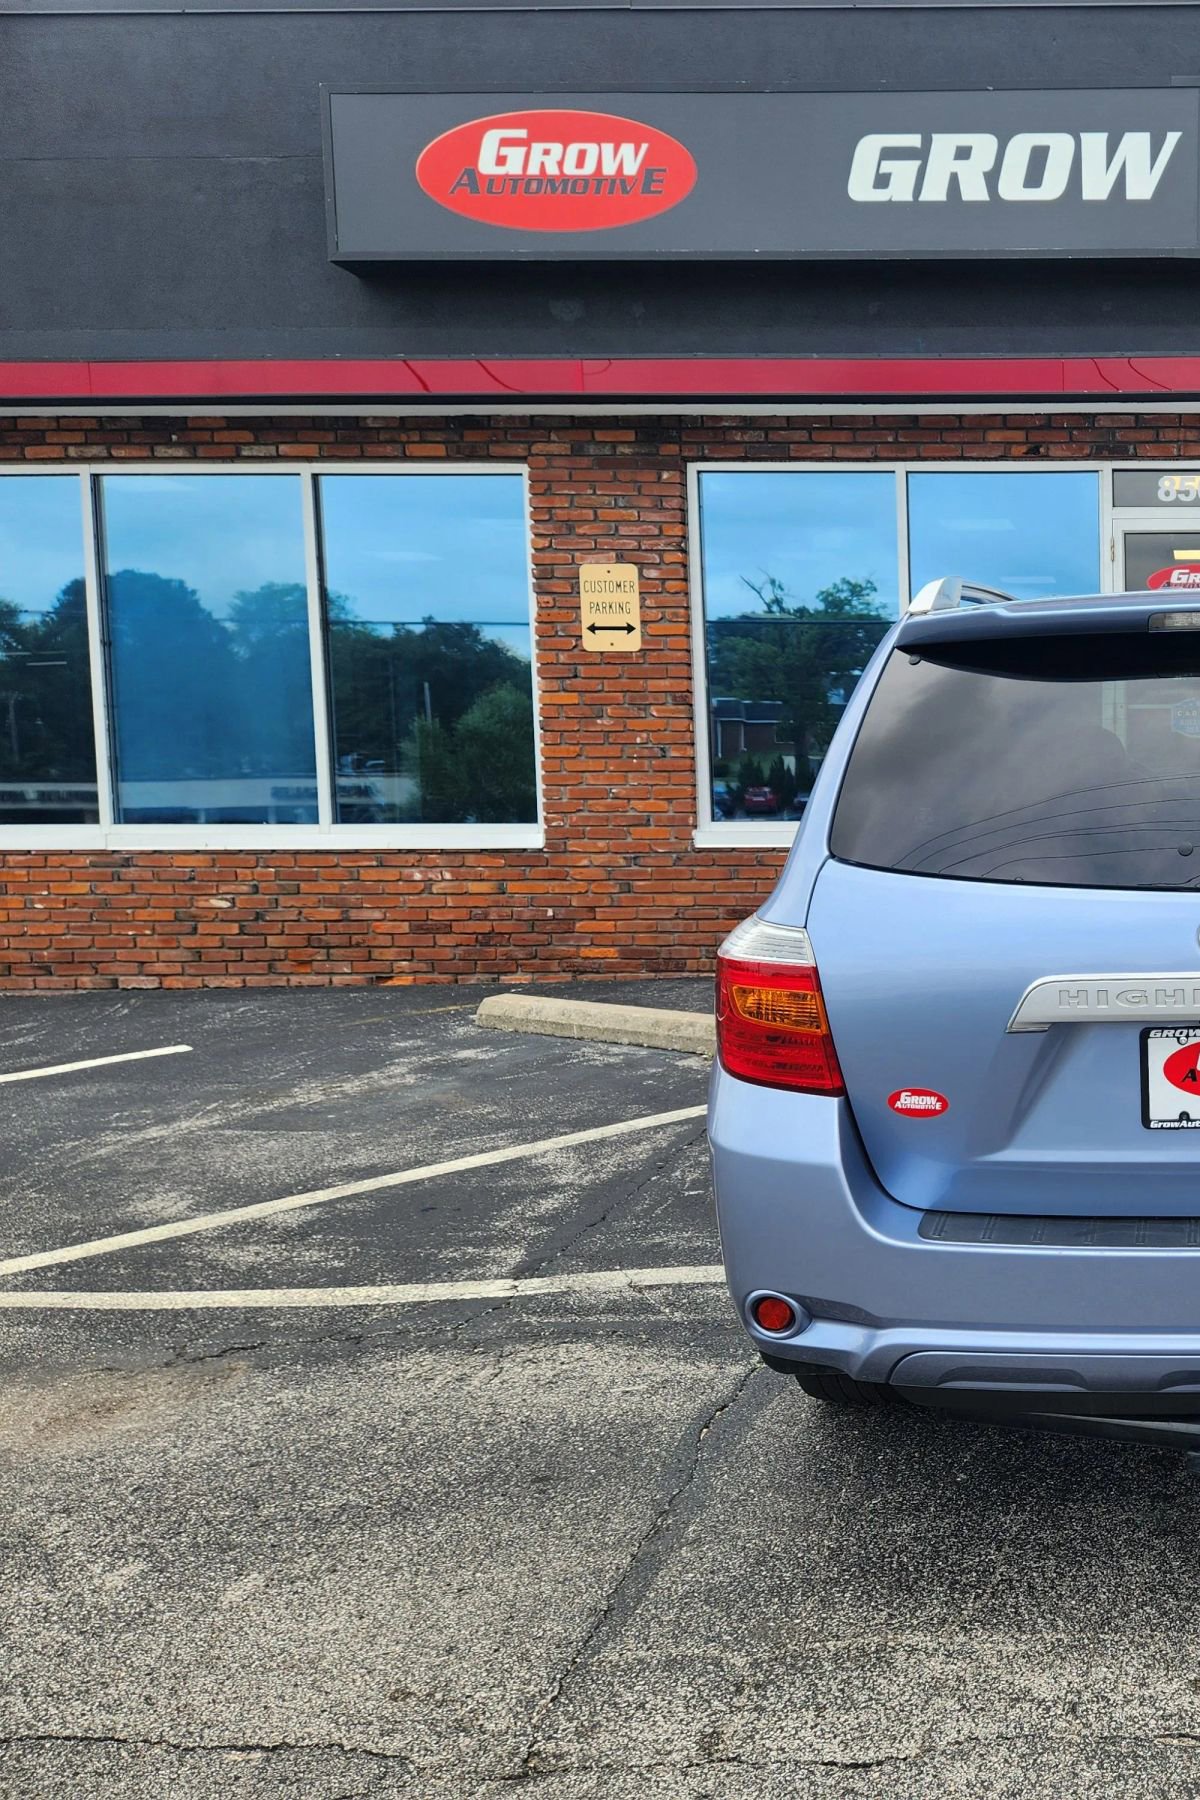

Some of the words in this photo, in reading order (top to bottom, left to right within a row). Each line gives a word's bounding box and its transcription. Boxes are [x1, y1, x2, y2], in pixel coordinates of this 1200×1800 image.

[847, 131, 1182, 202] GROW
[583, 580, 635, 593] CUSTOMER
[589, 601, 631, 614] PARKING
